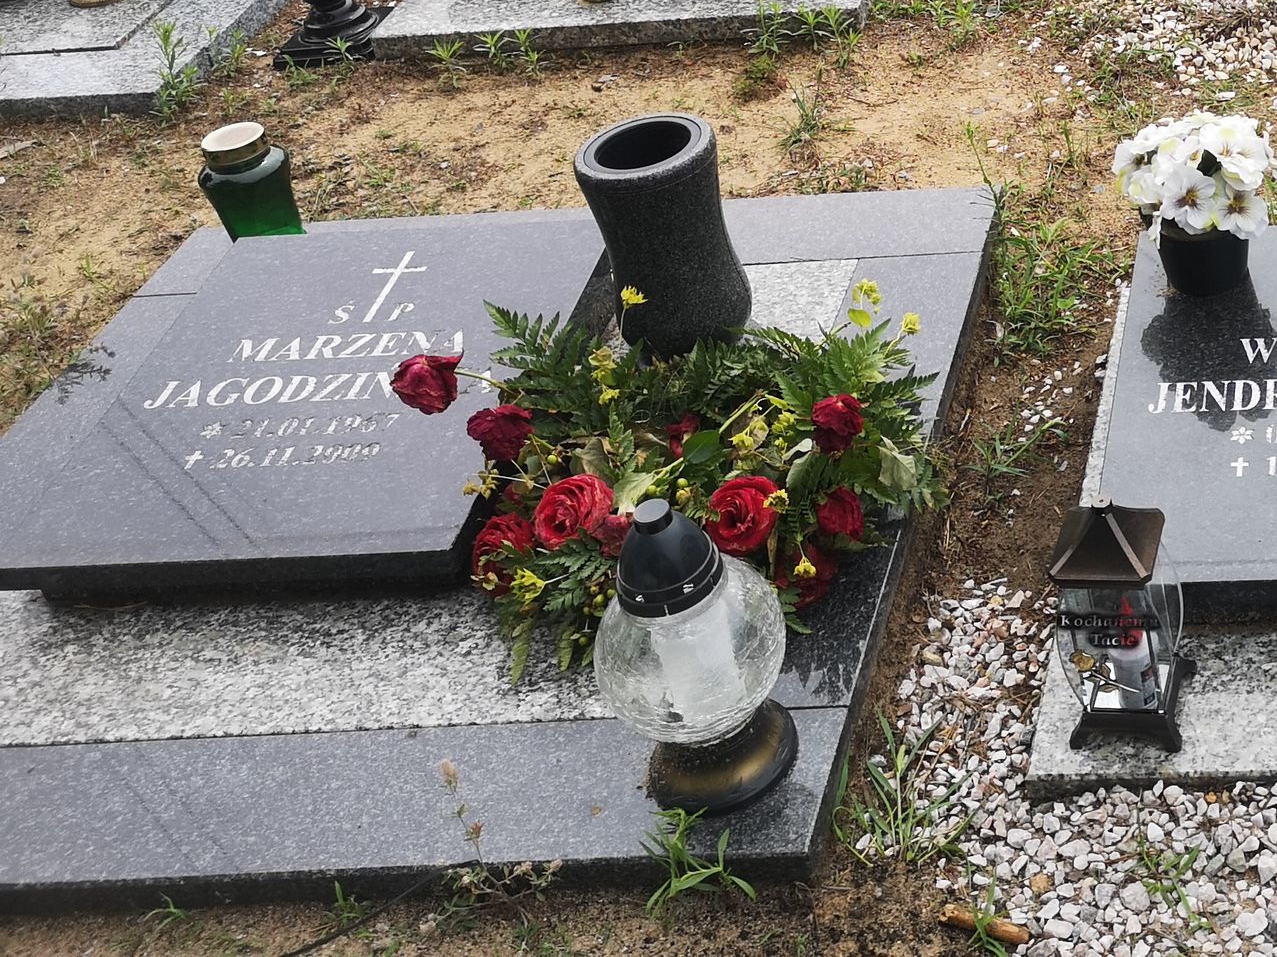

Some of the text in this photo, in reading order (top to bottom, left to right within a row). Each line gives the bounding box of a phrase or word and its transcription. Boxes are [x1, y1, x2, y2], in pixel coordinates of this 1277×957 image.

[328, 301, 415, 325] Ś P
[226, 329, 465, 363] MARZENA
[1090, 633, 1135, 646] Tacie
